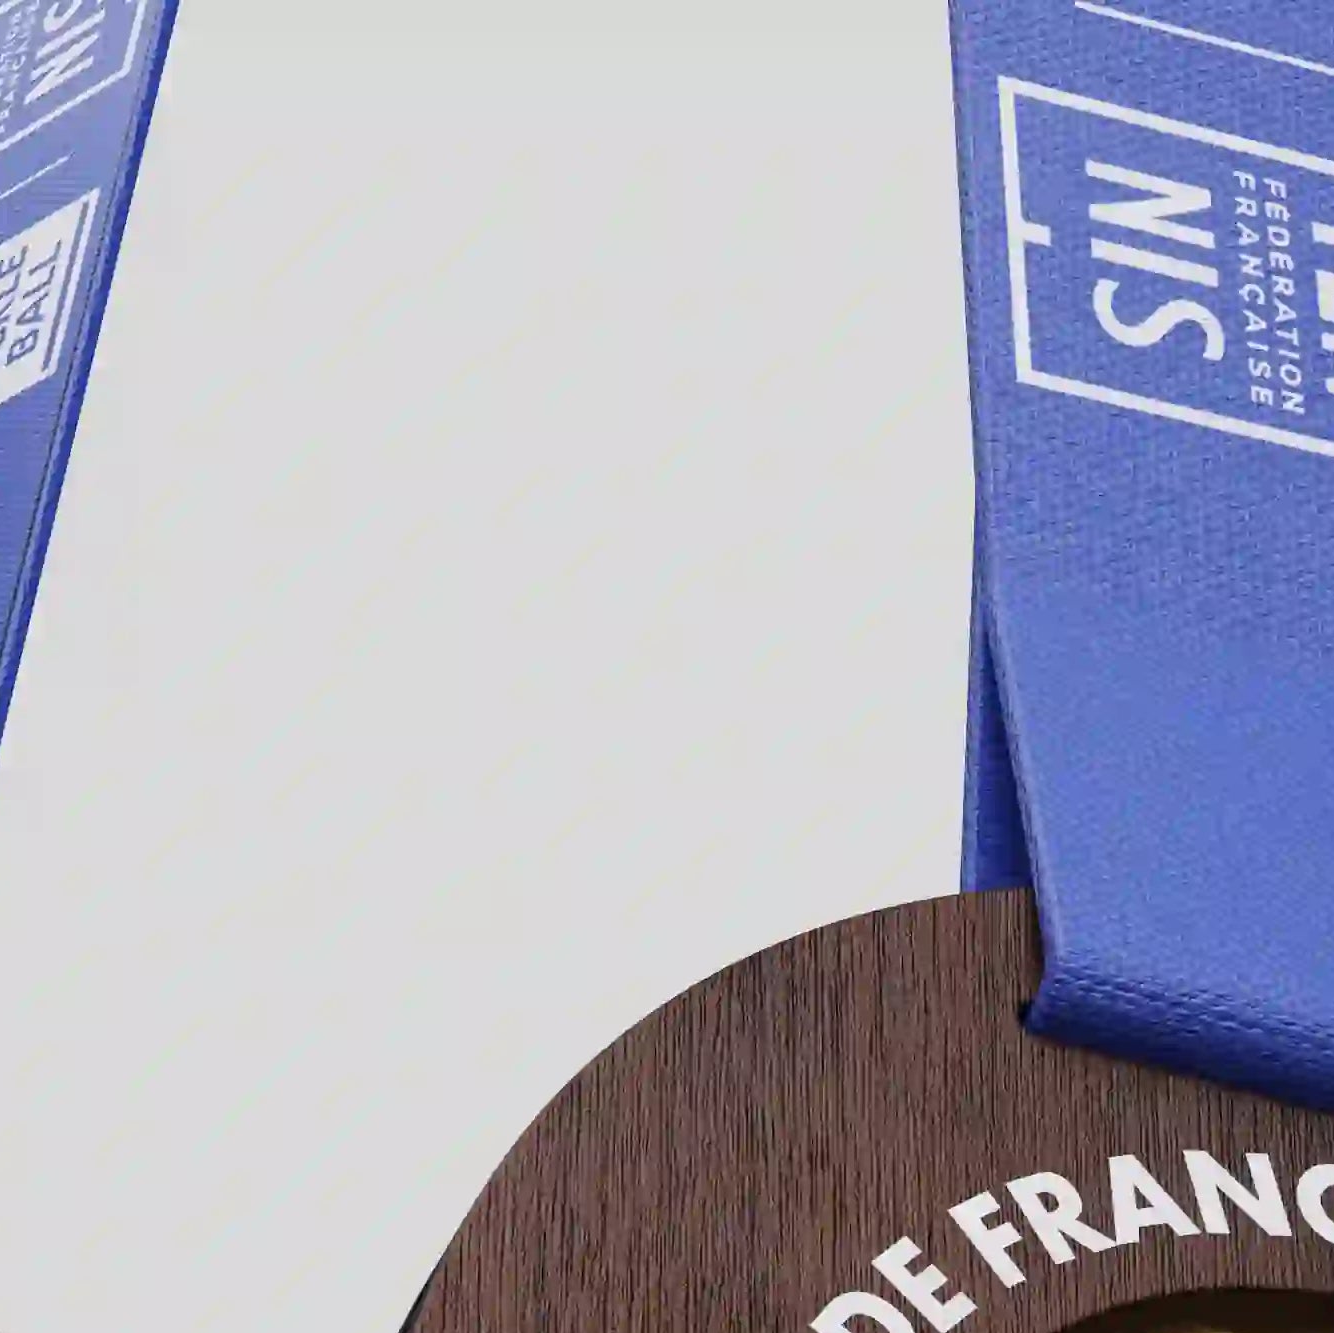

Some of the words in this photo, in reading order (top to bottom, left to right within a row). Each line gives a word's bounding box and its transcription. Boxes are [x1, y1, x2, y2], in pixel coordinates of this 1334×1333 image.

[5, 240, 62, 367] BALL
[1086, 159, 1224, 360] NIS
[1233, 171, 1274, 406] FRANÇAISE
[1263, 178, 1305, 414] FÉDÉRATION
